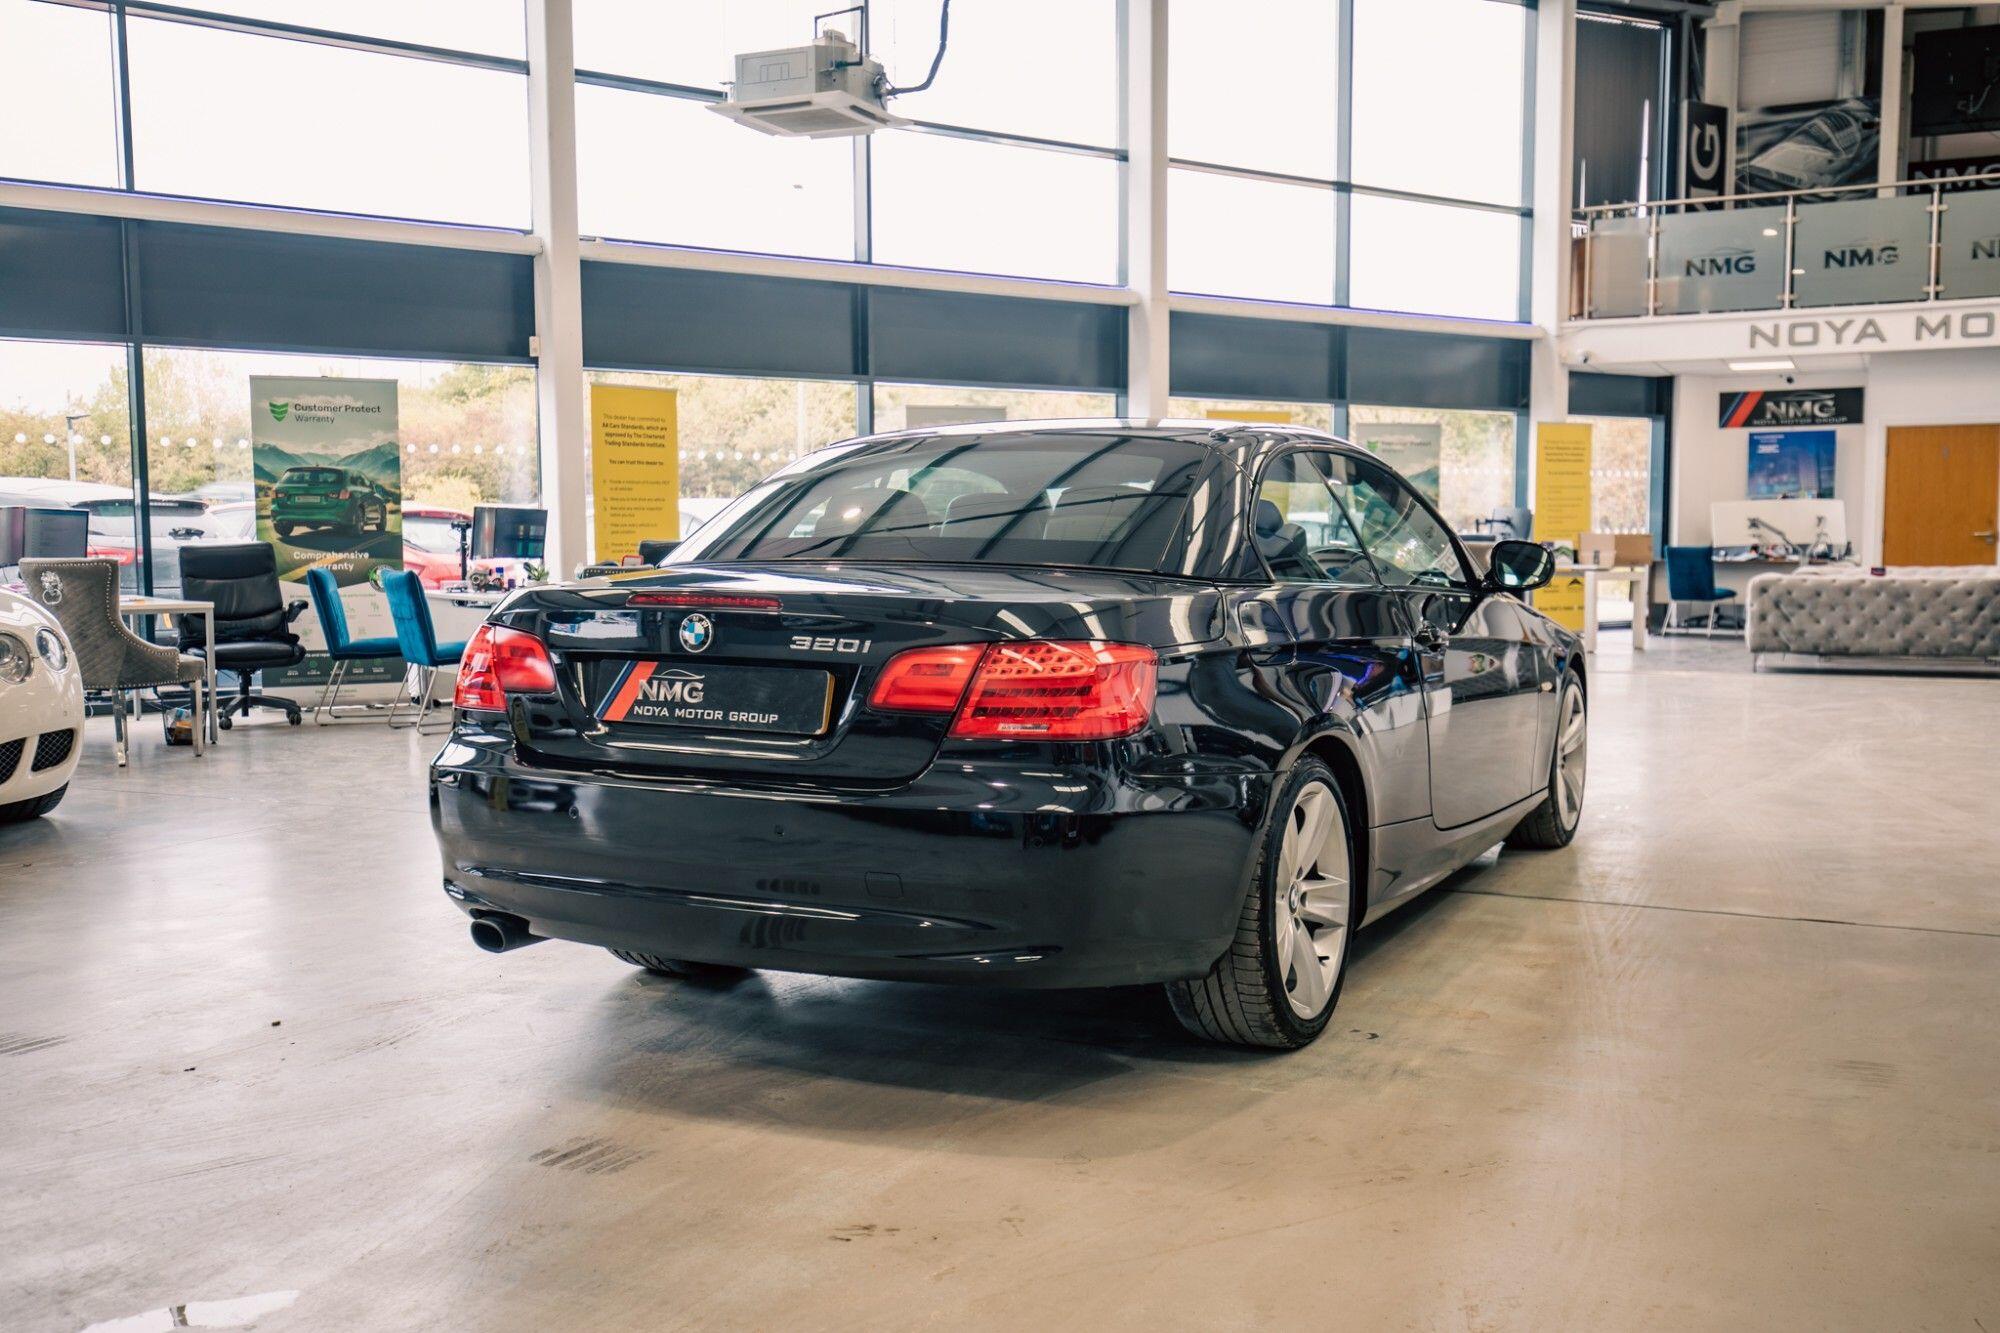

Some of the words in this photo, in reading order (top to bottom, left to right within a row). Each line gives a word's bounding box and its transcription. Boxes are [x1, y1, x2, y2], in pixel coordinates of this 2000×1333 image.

[1685, 256, 1756, 276] NMG
[1824, 246, 1899, 269] NMG
[1750, 318, 1887, 349] NOYA
[1915, 312, 1995, 341] MO
[294, 403, 342, 412] Customer
[344, 404, 382, 413] Protect
[1764, 399, 1836, 420] NMG
[295, 414, 335, 424] Warranty
[293, 551, 370, 561] Comprehensive
[636, 678, 705, 704] NMG
[633, 705, 669, 717] NOYA
[674, 708, 724, 721] MOTOR
[728, 711, 779, 724] GROUP
